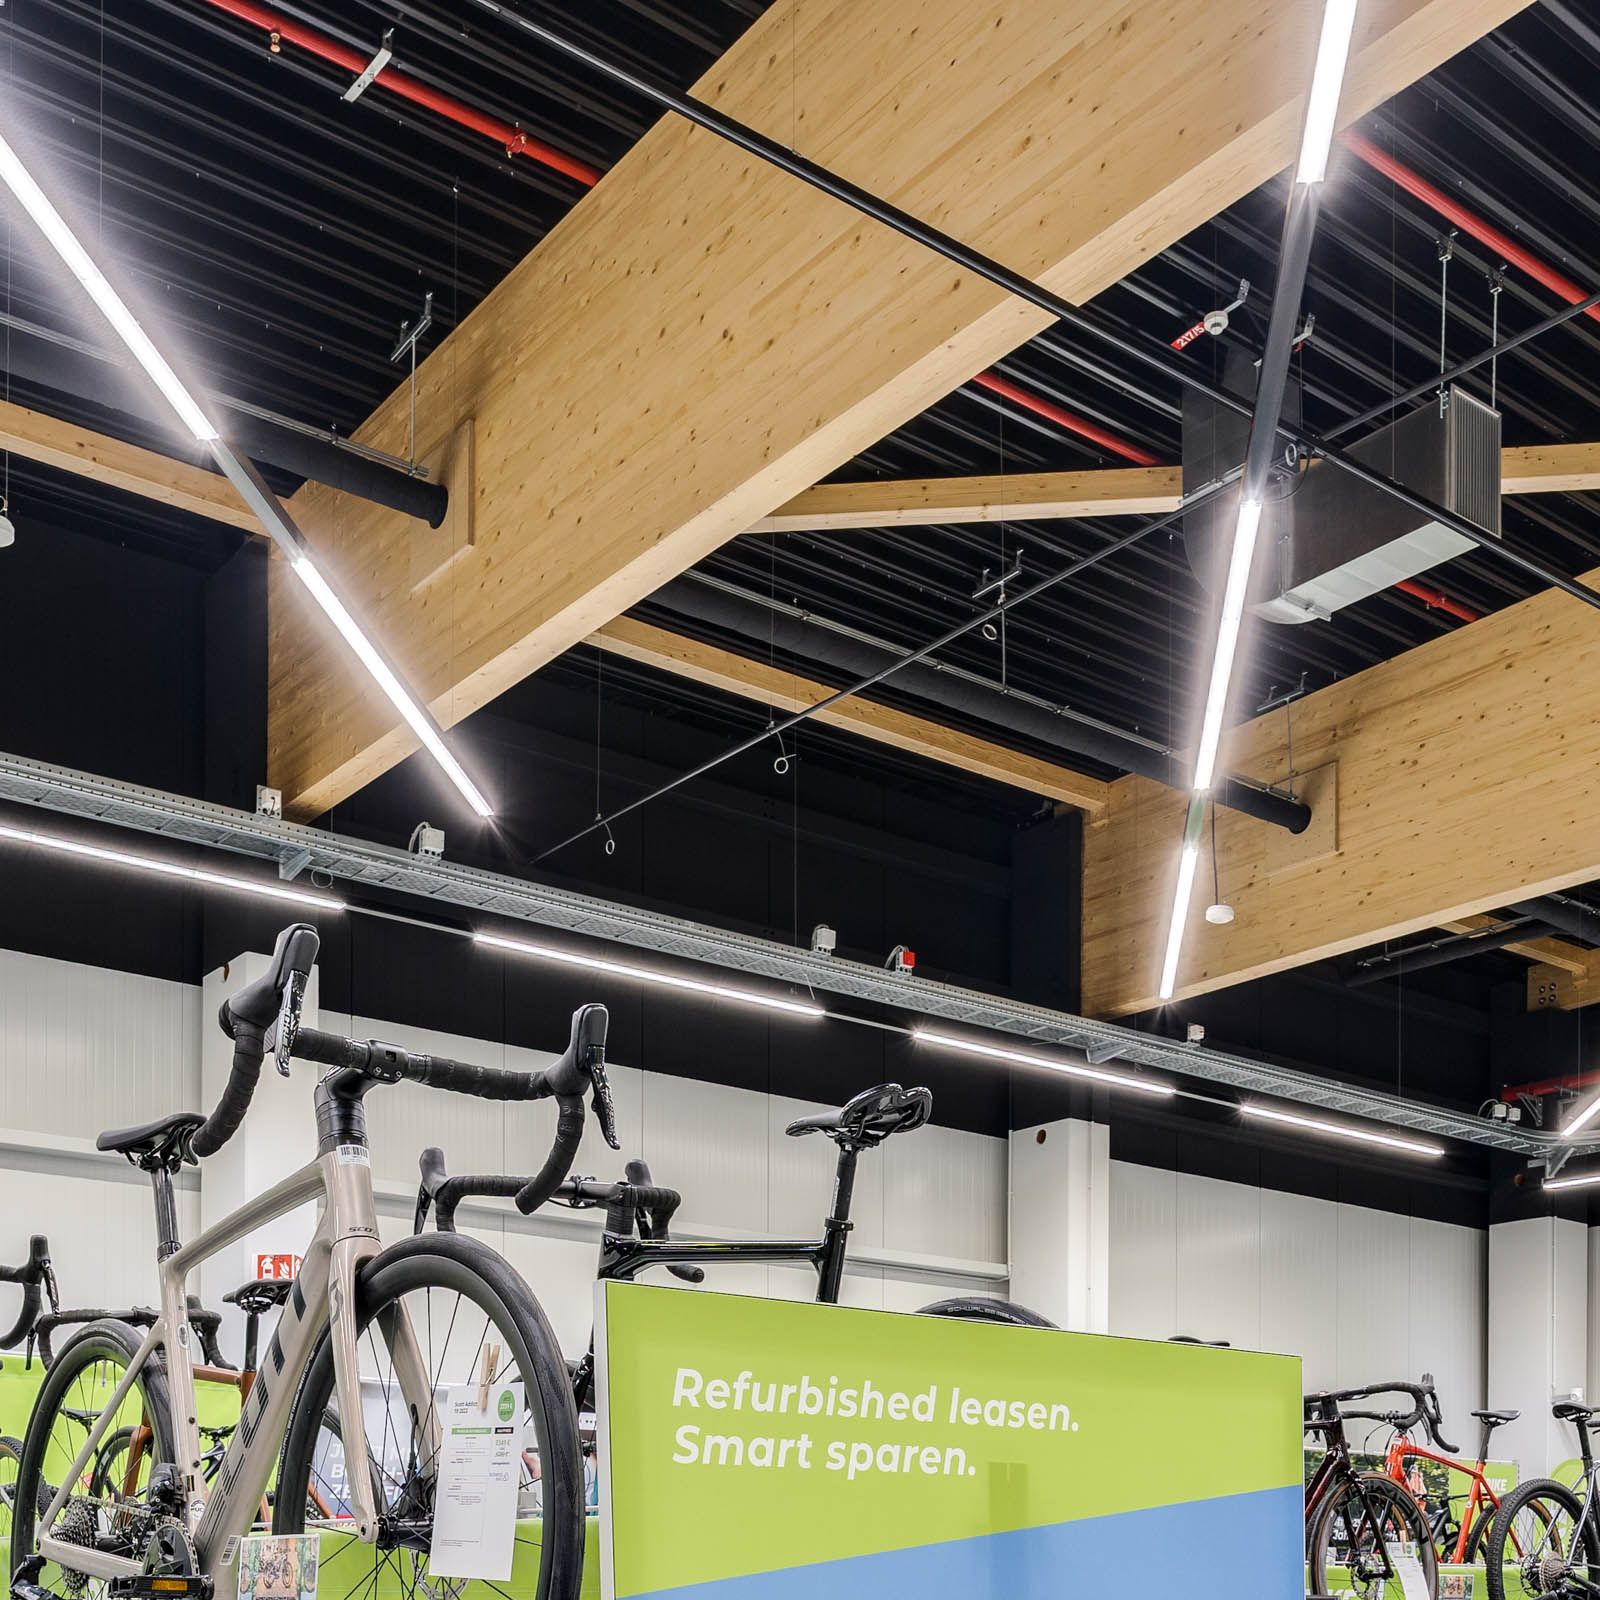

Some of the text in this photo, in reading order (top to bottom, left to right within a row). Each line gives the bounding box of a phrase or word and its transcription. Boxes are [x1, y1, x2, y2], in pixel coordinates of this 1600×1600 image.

[672, 1368, 1079, 1433] Refurbished leasen.
[671, 1426, 977, 1481] Smart sparen.
